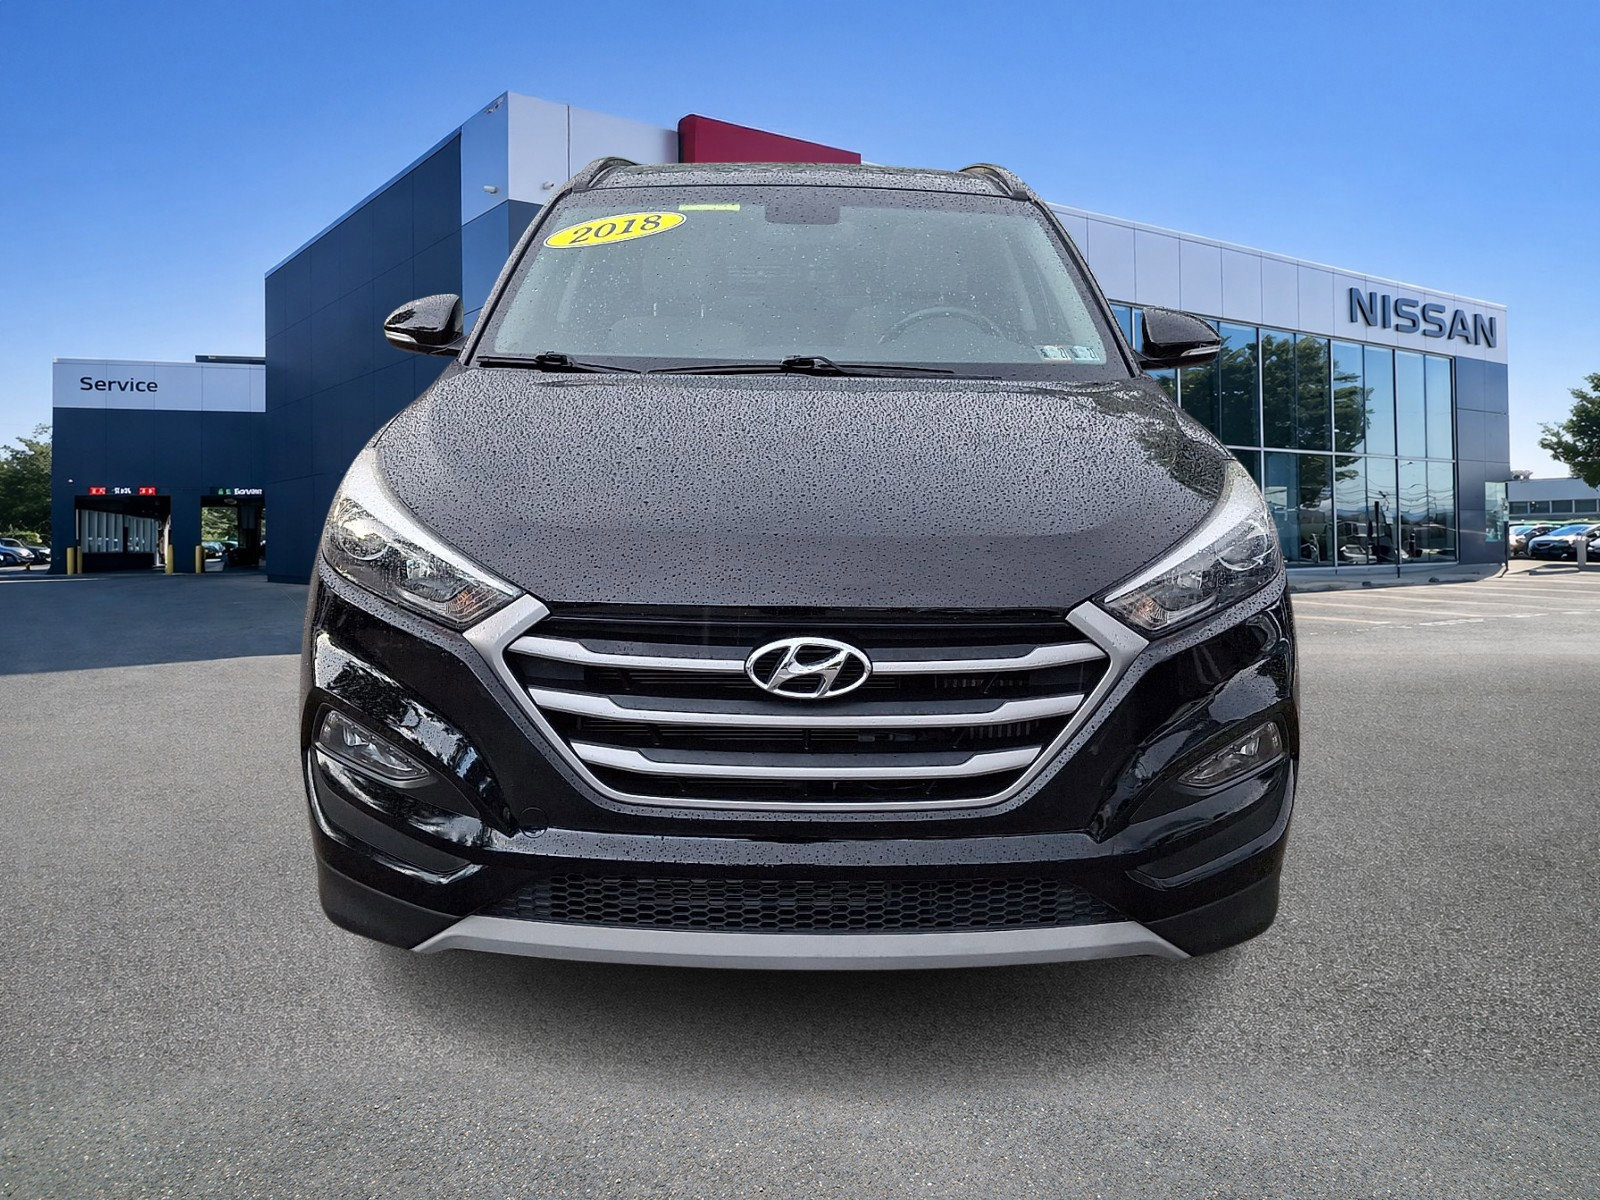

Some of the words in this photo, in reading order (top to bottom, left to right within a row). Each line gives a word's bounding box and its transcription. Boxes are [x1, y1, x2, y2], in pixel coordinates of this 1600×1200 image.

[569, 214, 663, 244] 2018
[1349, 287, 1497, 348] NISSAN
[80, 376, 158, 393] Service
